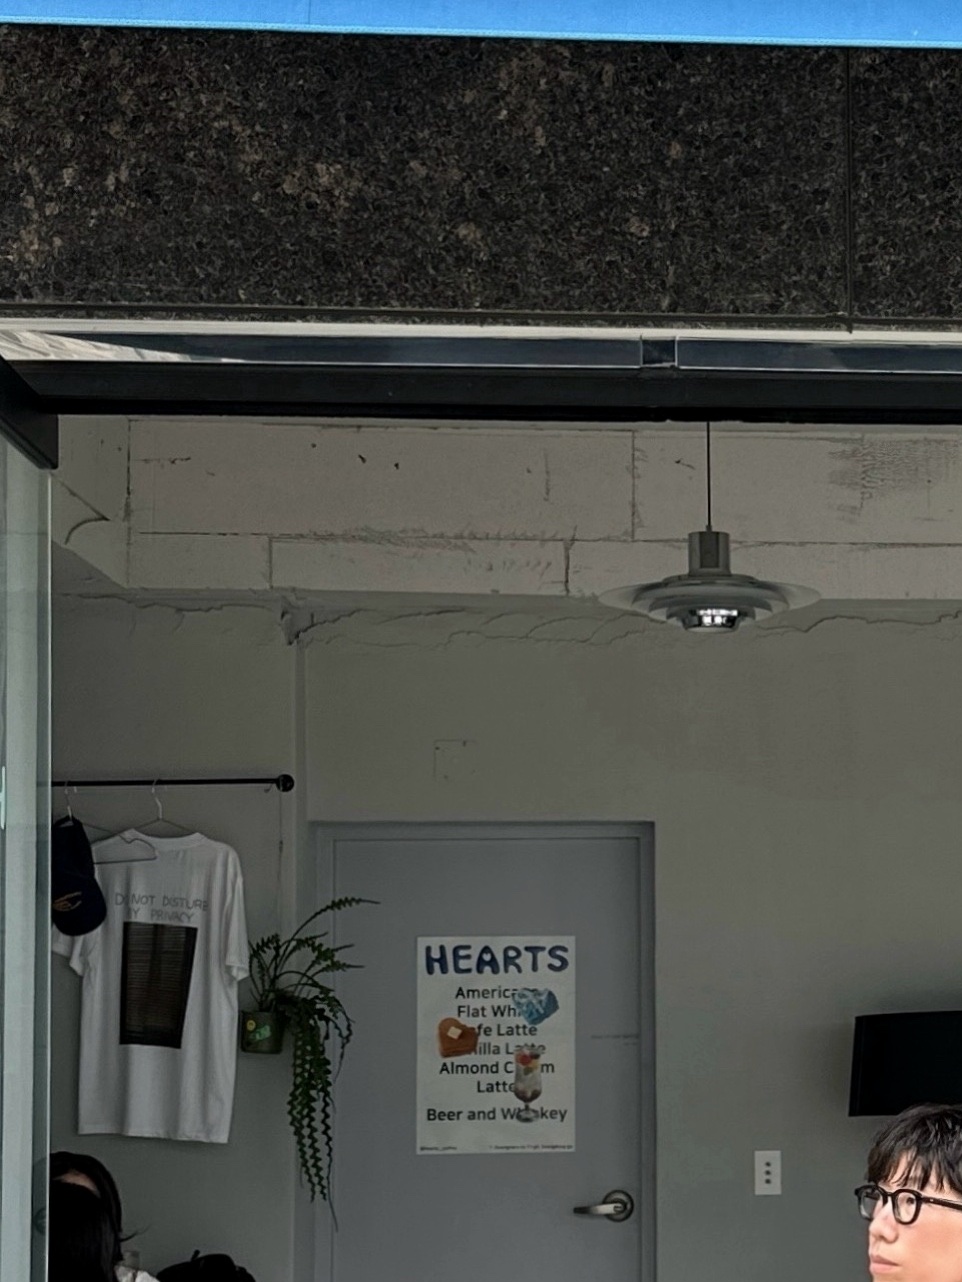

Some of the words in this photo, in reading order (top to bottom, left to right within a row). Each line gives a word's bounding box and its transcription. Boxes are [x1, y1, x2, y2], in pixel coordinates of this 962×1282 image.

[131, 894, 155, 905] NOT
[150, 908, 195, 923] PRIVACY
[425, 944, 569, 975] HEARTS
[457, 1005, 487, 1018] Flat
[497, 1023, 538, 1036] Latte
[439, 1062, 499, 1074] Almond
[427, 1109, 463, 1121] Beer
[467, 1108, 496, 1121] and
